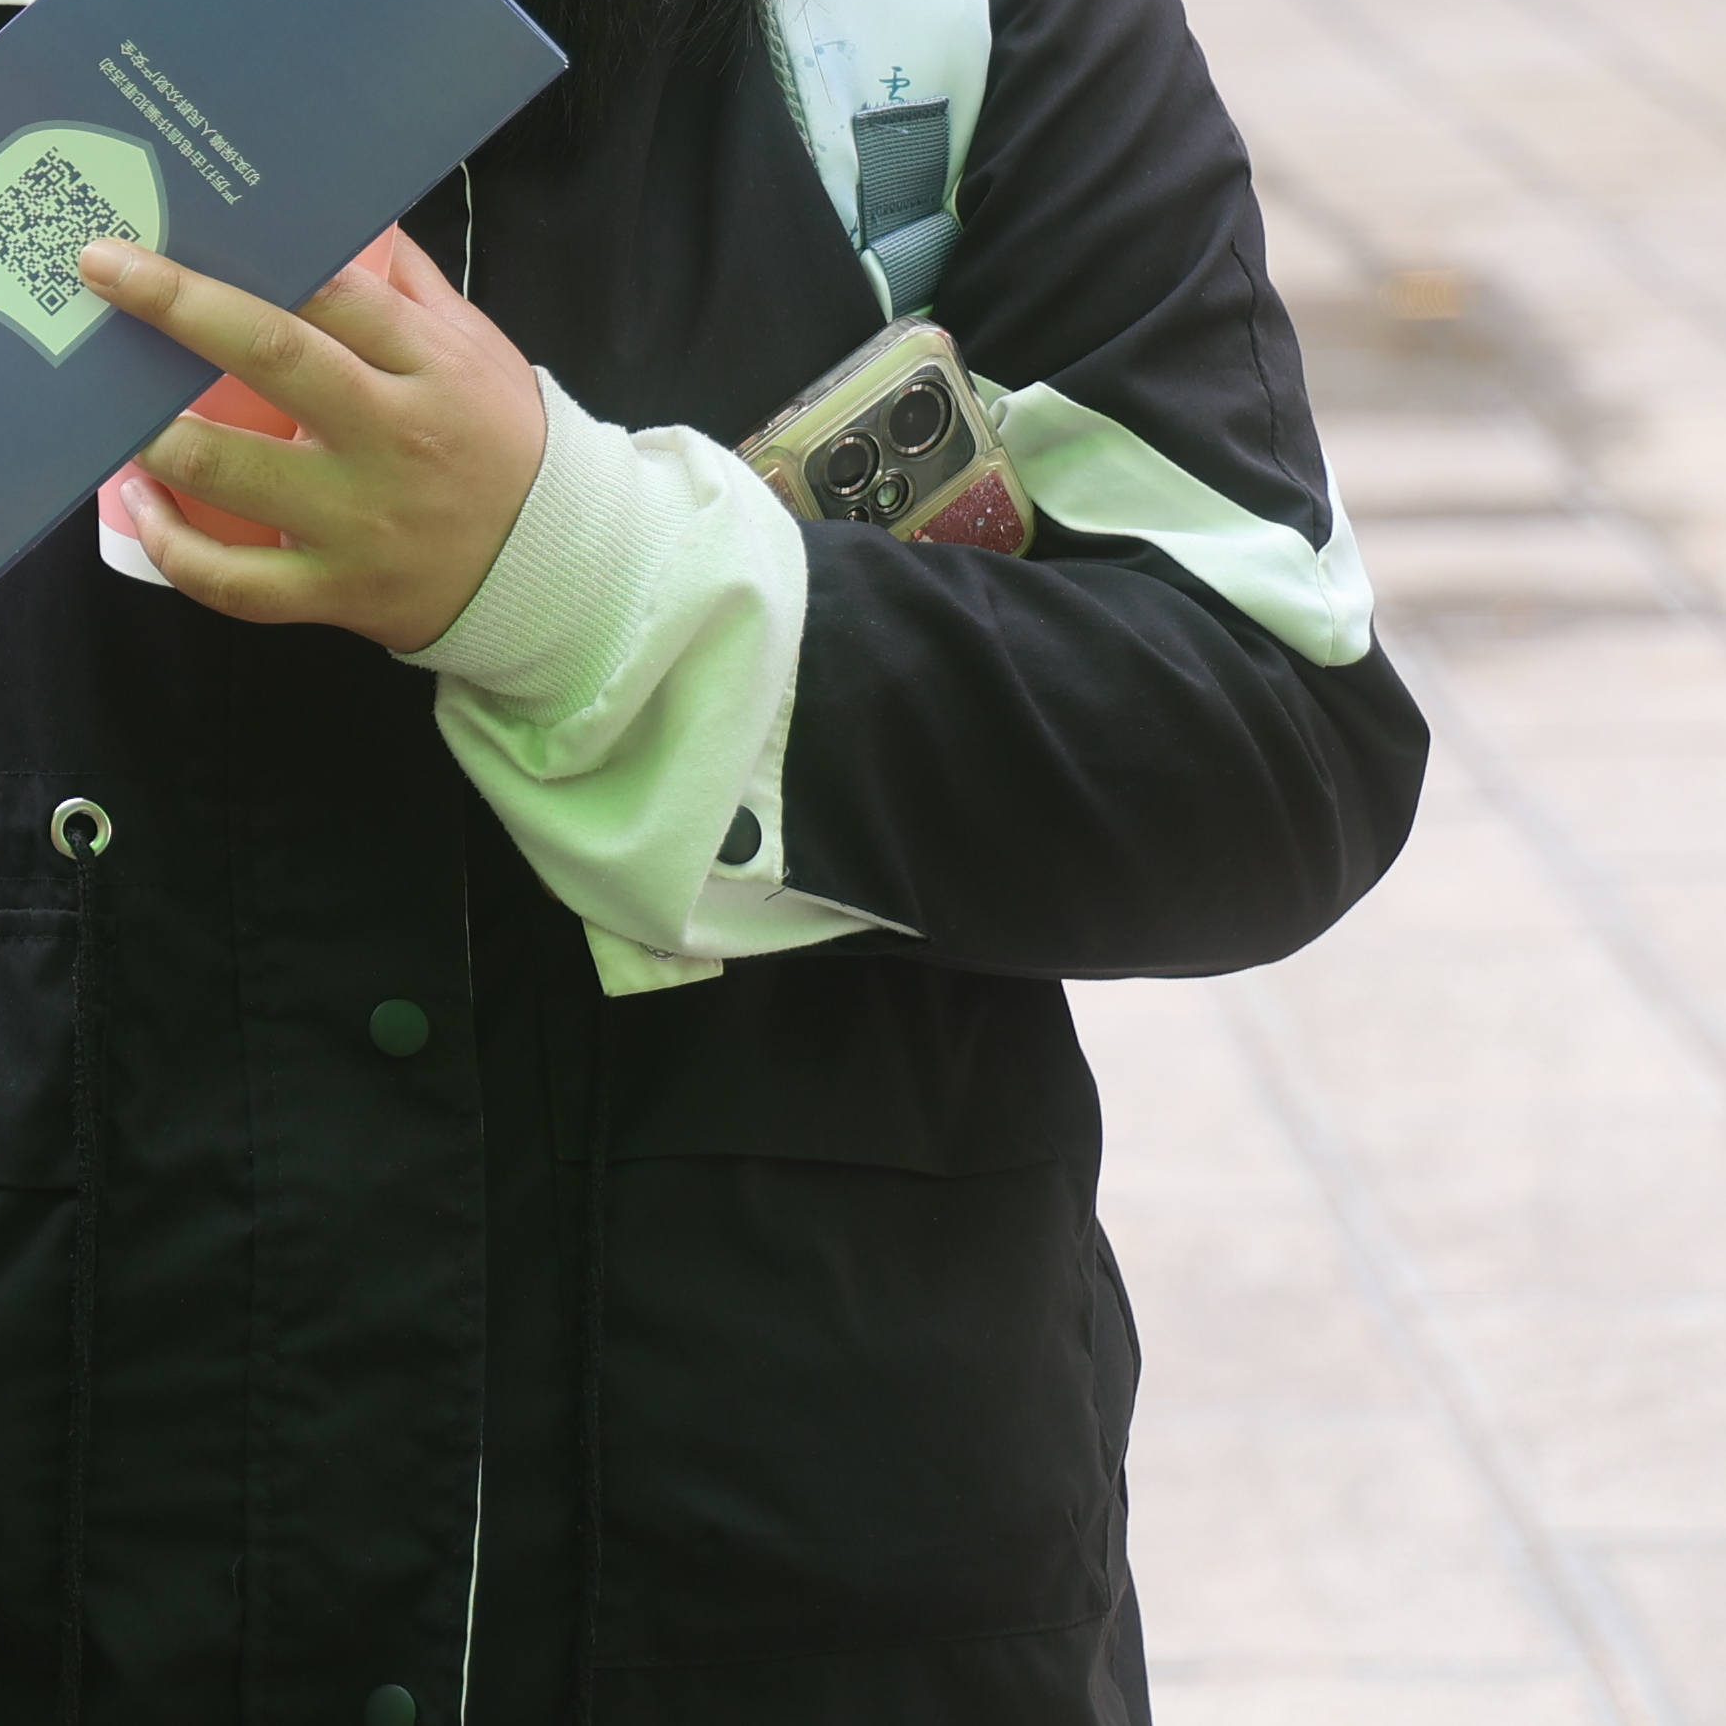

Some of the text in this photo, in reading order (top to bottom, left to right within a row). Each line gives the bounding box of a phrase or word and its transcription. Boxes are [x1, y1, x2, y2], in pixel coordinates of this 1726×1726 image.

[99, 57, 242, 205] 严厉打击电信诈骗犯罪活动
[120, 39, 261, 186] 切实保障人民群众财产安全
